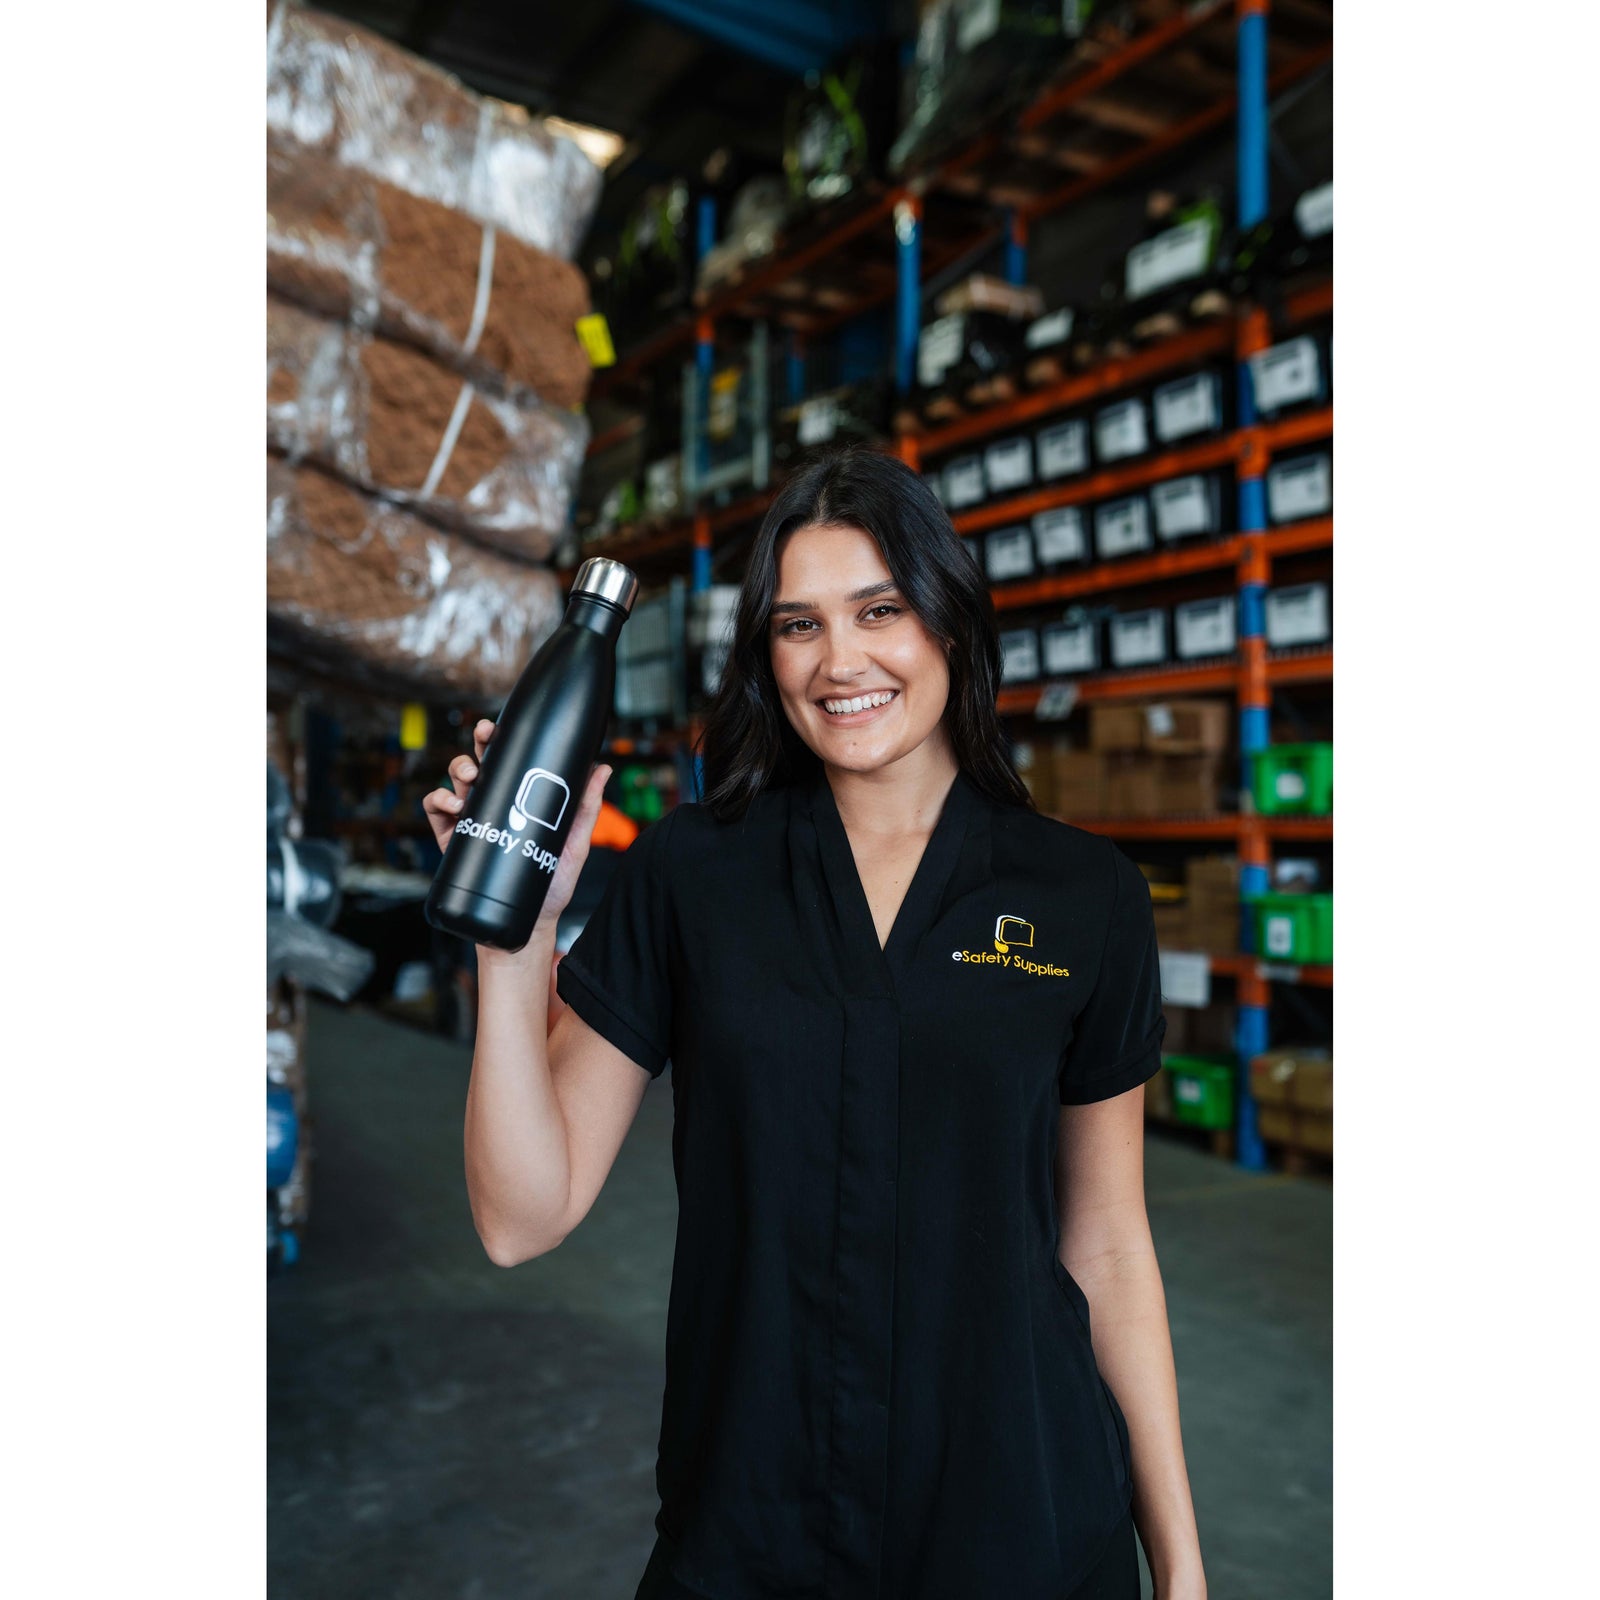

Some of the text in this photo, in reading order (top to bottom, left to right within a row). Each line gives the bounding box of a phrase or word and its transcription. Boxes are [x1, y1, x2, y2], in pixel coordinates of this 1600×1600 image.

[455, 818, 520, 854] eSafety
[952, 950, 1070, 976] eSafety Supplies
